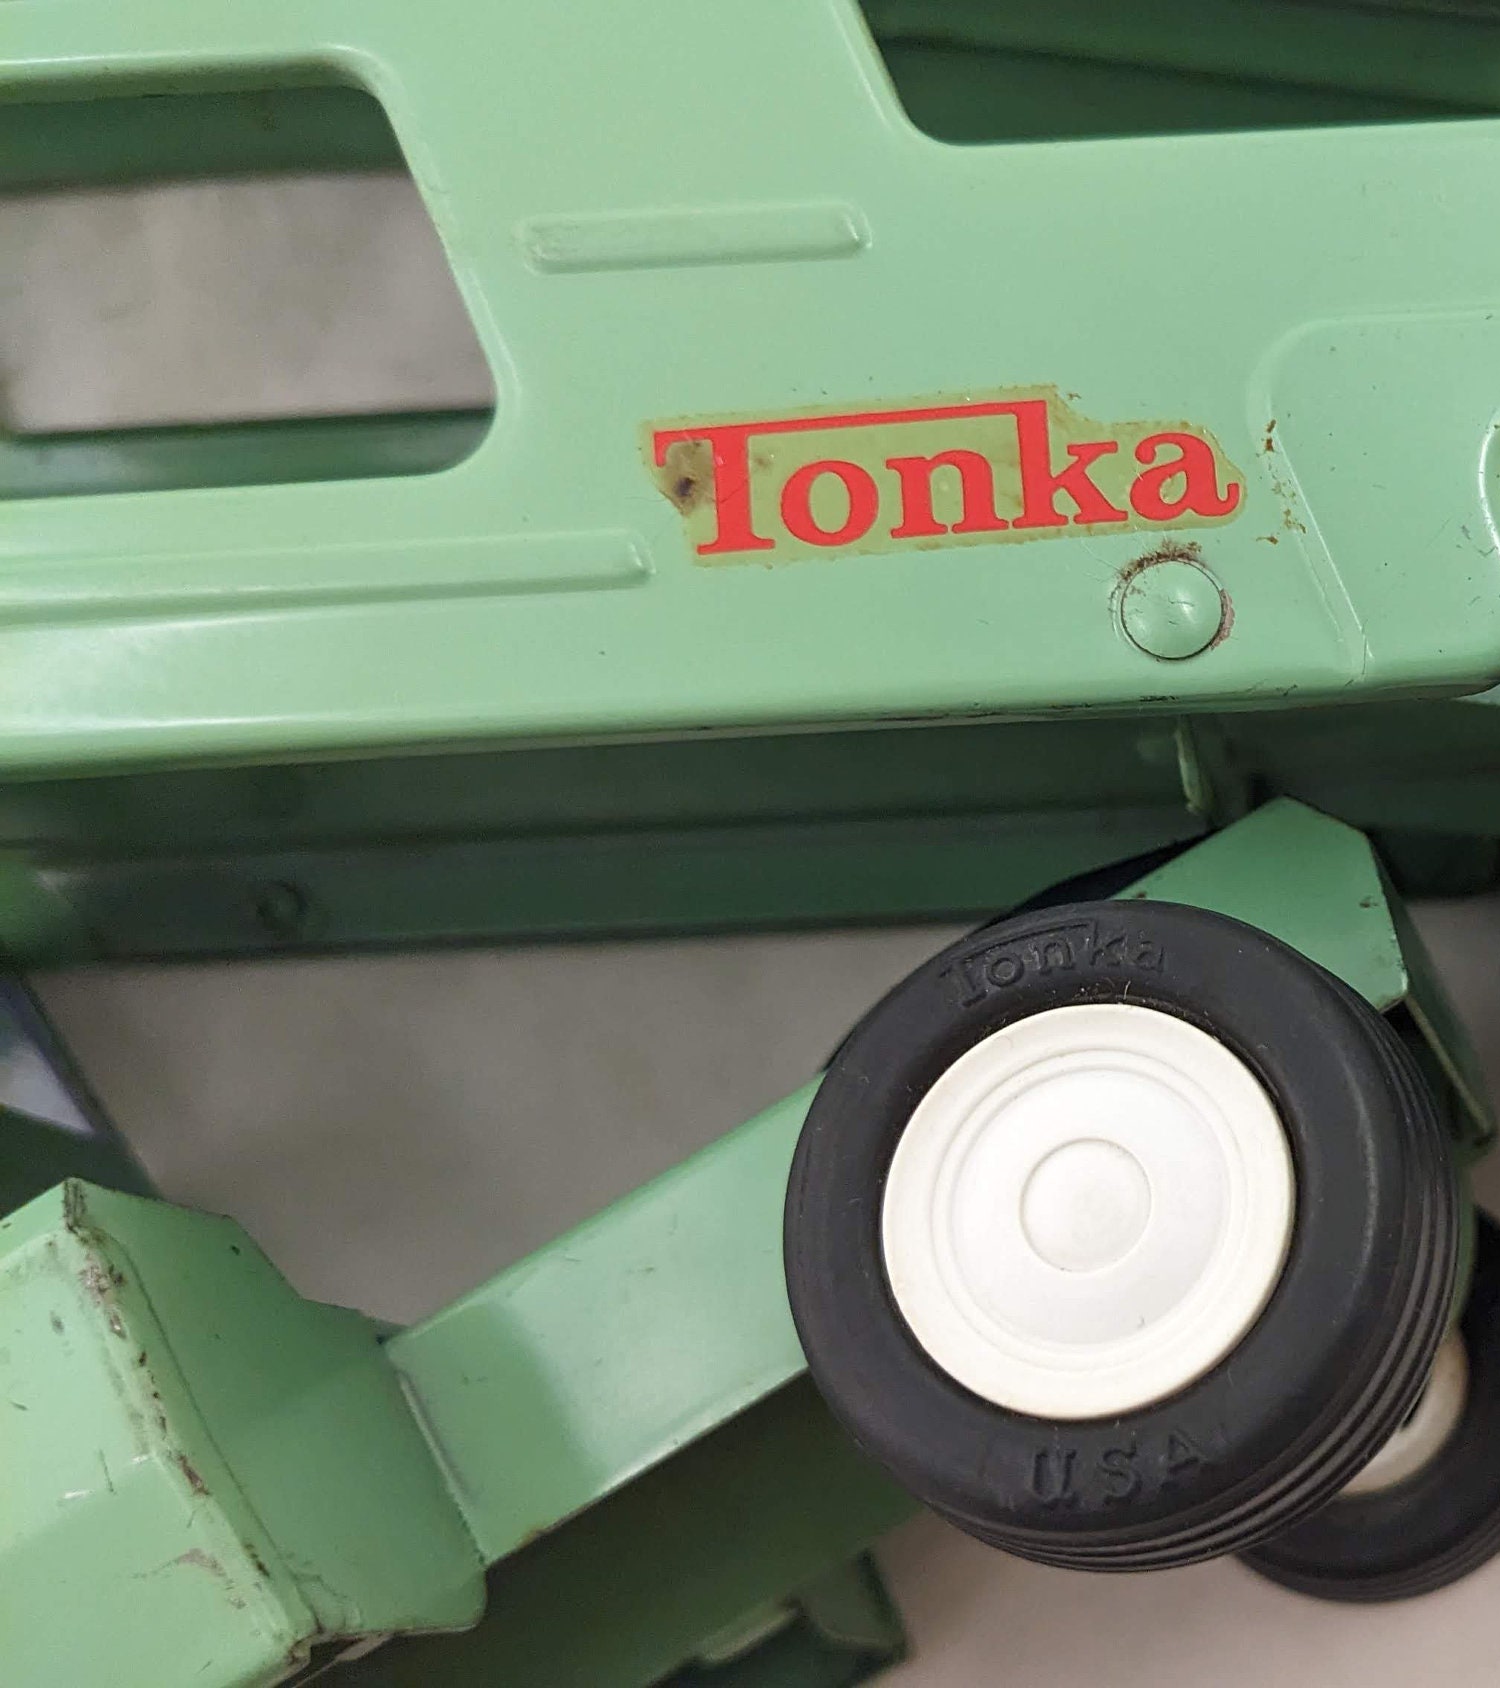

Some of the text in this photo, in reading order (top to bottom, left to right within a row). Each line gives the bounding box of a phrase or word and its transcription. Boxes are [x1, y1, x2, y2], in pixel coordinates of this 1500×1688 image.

[652, 399, 1241, 556] Tonka
[939, 916, 1167, 1008] Tonka
[1028, 1428, 1205, 1509] USA
